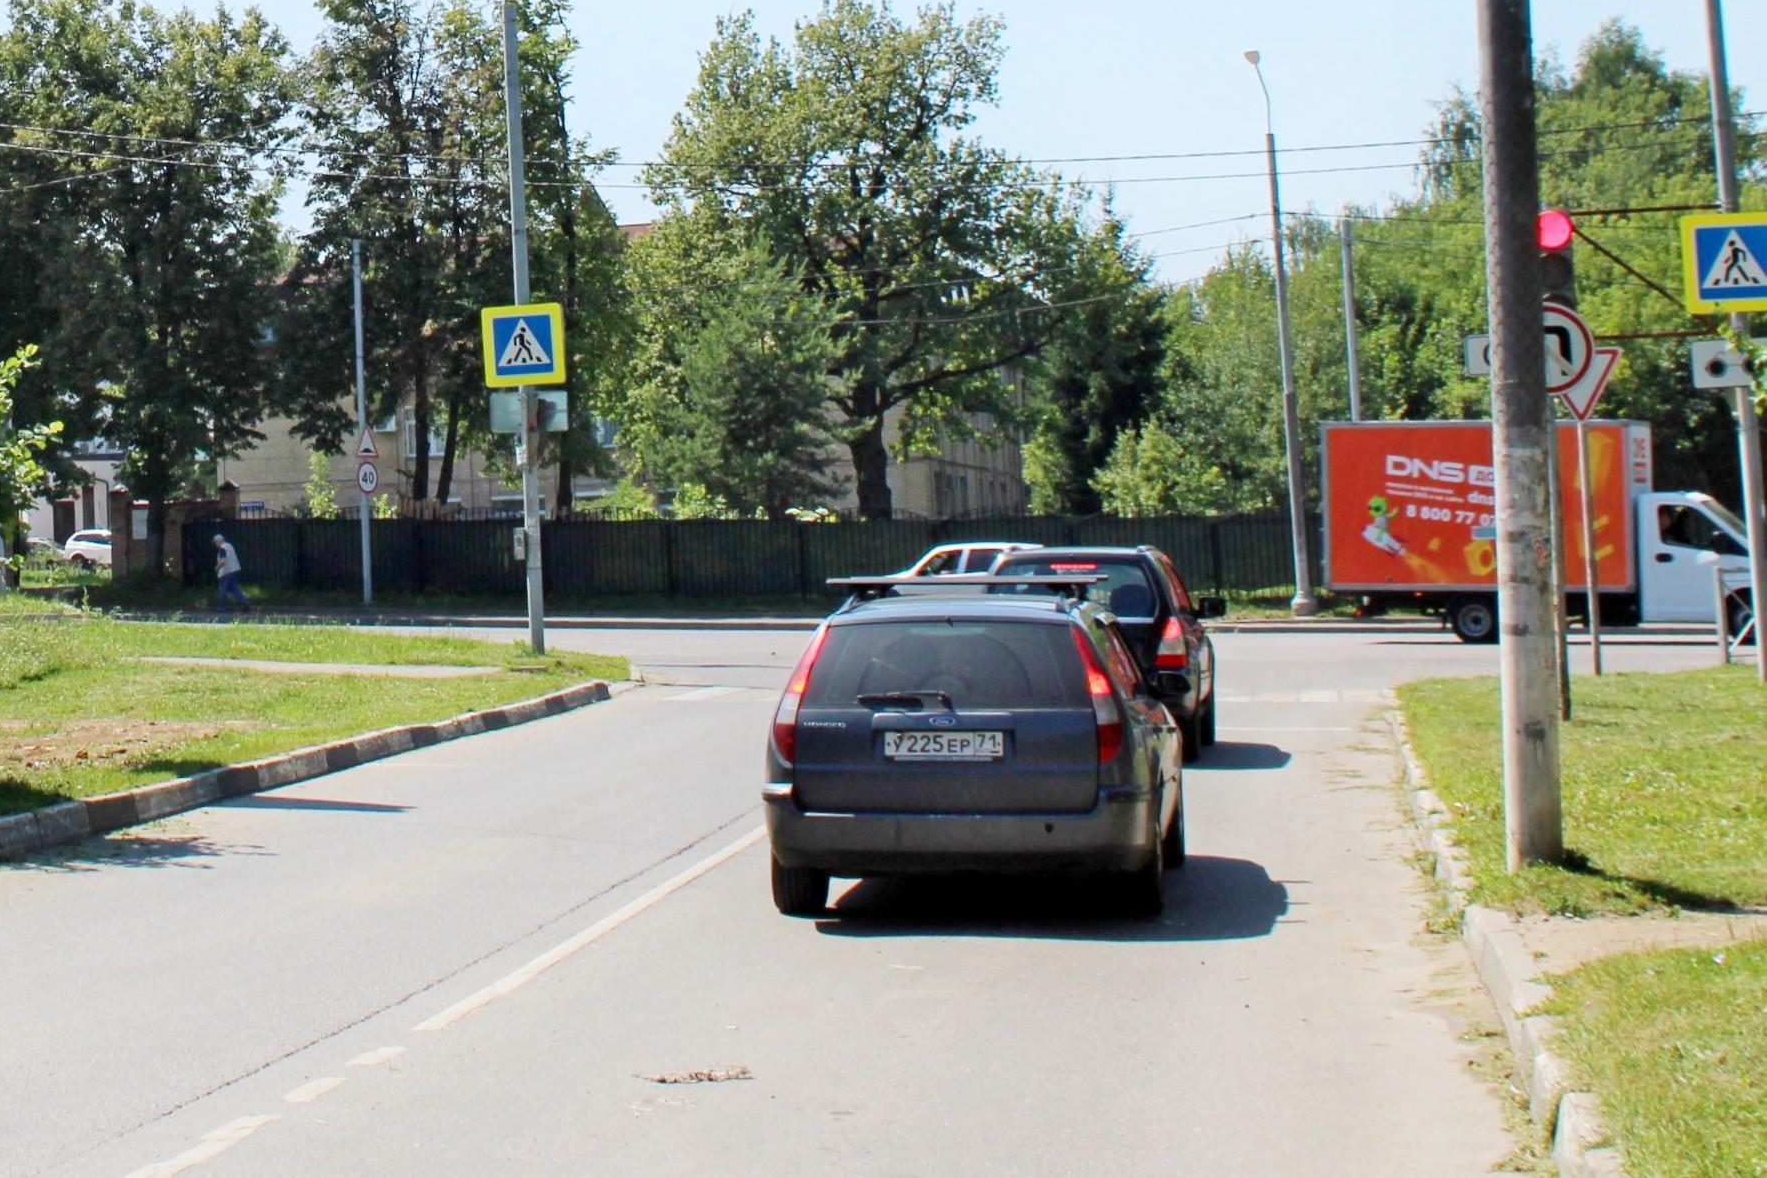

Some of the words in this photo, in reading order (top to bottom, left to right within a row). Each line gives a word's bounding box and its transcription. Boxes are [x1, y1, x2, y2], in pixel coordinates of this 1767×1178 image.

[361, 471, 375, 484] 40
[1385, 454, 1465, 483] DNS
[1405, 503, 1418, 518] 8
[1420, 505, 1452, 522] 800
[1454, 509, 1476, 525] 77
